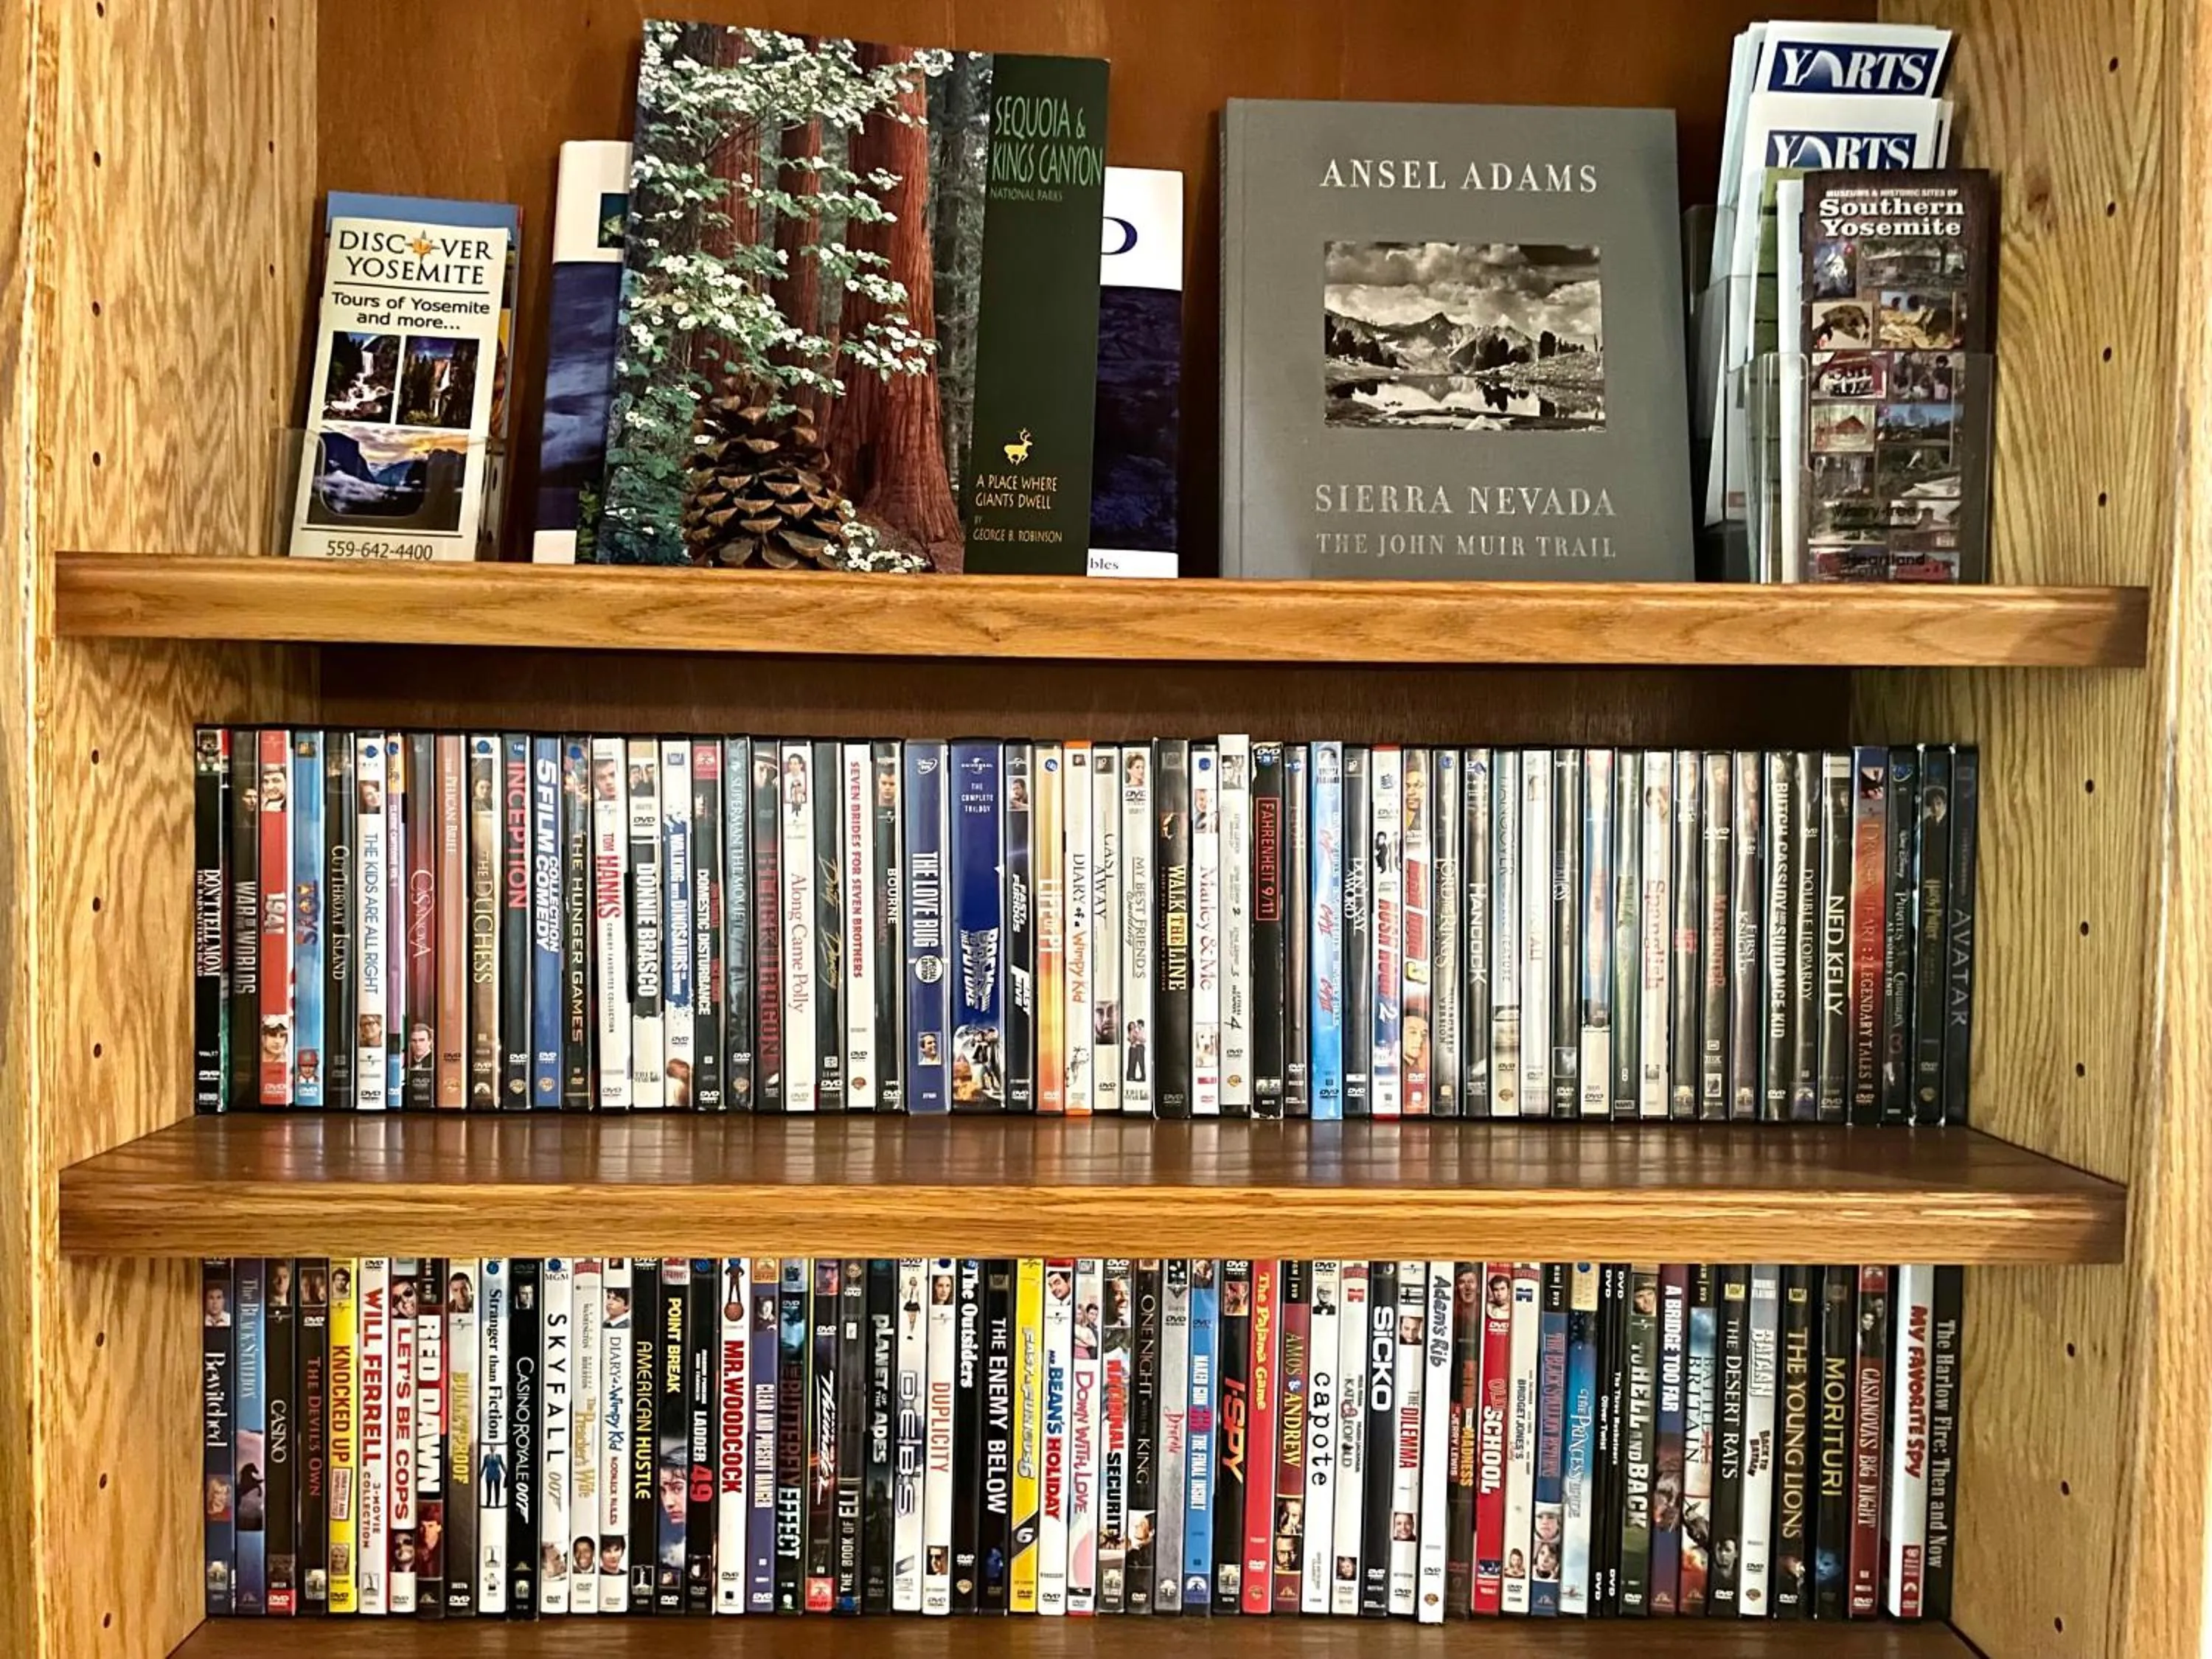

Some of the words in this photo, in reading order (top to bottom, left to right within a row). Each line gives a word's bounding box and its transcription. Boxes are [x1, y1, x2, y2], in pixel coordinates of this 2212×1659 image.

[995, 96, 1070, 139] SEQUOIA
[1075, 108, 1086, 140] &
[992, 142, 1034, 184] KINGS
[1038, 145, 1104, 187] CANYON
[1319, 158, 1447, 189] ANSEL
[1459, 161, 1599, 193] ADAMS
[990, 187, 1034, 201] NATIONAL
[1818, 197, 1965, 218] Southern
[1820, 218, 1962, 238] Yosemite
[345, 255, 484, 285] YOSEMITE
[332, 291, 379, 308] Tours
[387, 295, 406, 310] of
[411, 297, 490, 315] Yosemite
[356, 310, 391, 326] and
[397, 314, 461, 330] more...
[975, 492, 1014, 509] GIANTS
[1018, 493, 1051, 510] DWELL
[976, 474, 986, 489] A
[988, 474, 1019, 491] PLACE
[1021, 476, 1058, 493] WHERE
[1315, 483, 1454, 514] SIERRA
[1468, 485, 1618, 517] NEVADA
[325, 539, 433, 561] 559-642-4400
[973, 528, 1006, 542] GEORGE
[1018, 530, 1063, 544] ROBINSON
[1315, 532, 1368, 555] THE
[1377, 534, 1445, 557] JOHN
[1456, 535, 1526, 557] MUIR
[1536, 537, 1618, 559] TRAIL
[537, 759, 556, 785] 5
[850, 762, 860, 801] SEVEN
[507, 762, 526, 908] INCEPTION
[537, 785, 554, 850] FILM
[851, 803, 861, 847] BRIDES
[364, 832, 378, 858] THE
[477, 850, 490, 877] THE
[571, 832, 583, 870] THE
[602, 832, 614, 851] TOM
[851, 852, 861, 875] FOR
[1260, 803, 1275, 883] FAHRENHEIT
[365, 860, 378, 894] KIDS
[597, 855, 622, 919] HANKS
[912, 852, 937, 878] THE
[1168, 863, 1186, 912] WALK
[234, 881, 256, 915] WAR
[265, 891, 286, 935] 1941
[365, 897, 378, 922] ARE
[536, 855, 549, 950] COMEDY
[549, 856, 559, 953] COLLECTION
[636, 862, 657, 925] DONNIE
[697, 869, 710, 929] DOMESTIC
[787, 873, 805, 920] Along
[852, 878, 862, 915] SEVEN
[887, 868, 897, 924] BOURNE
[912, 880, 939, 915] LOVE
[1260, 886, 1274, 914] 9/11
[365, 925, 378, 950] ALL
[474, 880, 493, 984] DUCHESS
[572, 877, 584, 964] HUNGER
[913, 922, 939, 947] BUG
[1170, 915, 1185, 944] THE
[1468, 882, 1486, 985] HANCOCK
[234, 931, 256, 994] WORLDS
[637, 928, 658, 995] BRASCO
[791, 923, 807, 970] Came
[852, 918, 863, 978] BROTHERS
[1168, 945, 1186, 990] LINE
[1950, 908, 1972, 1026] AVATAR
[364, 953, 378, 994] RIGHT
[698, 933, 711, 1015] DISTURBANCE
[788, 973, 808, 1013] Polly
[572, 970, 584, 1044] GAMES
[1858, 964, 1875, 1035] LEGENDARY
[1858, 1041, 1873, 1079] TALES
[961, 1267, 978, 1300] The
[1257, 1272, 1270, 1303] The
[1430, 1276, 1450, 1335] Adam's
[1666, 1285, 1680, 1296] A
[364, 1287, 383, 1347] WILL
[485, 1289, 502, 1351] Stranger
[668, 1298, 681, 1340] POINT
[990, 1318, 1006, 1350] THE
[1139, 1294, 1155, 1339] ONE
[1256, 1305, 1270, 1364] Pajama
[1663, 1298, 1680, 1352] BRIDGE
[1726, 1319, 1739, 1349] THE
[1935, 1320, 1955, 1349] The
[396, 1327, 411, 1399] LET'S
[418, 1315, 441, 1380] RED
[489, 1354, 499, 1382] than
[959, 1304, 978, 1388] Outsiders
[1138, 1339, 1154, 1398] NIGHT
[1429, 1338, 1449, 1368] Rib
[1662, 1354, 1678, 1383] TOO
[1786, 1328, 1806, 1374] THE
[332, 1346, 351, 1432] KNOCKED
[636, 1341, 653, 1431] AMERICAN
[667, 1345, 681, 1393] BREAK
[1256, 1367, 1269, 1411] Game
[1723, 1355, 1741, 1427] DESERT
[1935, 1354, 1954, 1410] Harlow
[205, 1351, 226, 1447] Bewitched
[362, 1354, 383, 1467] FERRELL
[488, 1385, 502, 1439] Fiction
[756, 1384, 775, 1411] CLEAR
[989, 1356, 1007, 1430] ENEMY
[1661, 1385, 1677, 1412] FAR
[271, 1400, 286, 1464] CASINO
[396, 1406, 410, 1439] BE
[417, 1388, 439, 1492] DAWN
[452, 1372, 470, 1484] BULLETPROOF
[693, 1411, 707, 1461] LADDER
[756, 1413, 773, 1431] AND
[930, 1382, 950, 1472] DUPLICITY
[1308, 1372, 1332, 1486] capote
[1784, 1381, 1806, 1466] YOUNG
[1820, 1357, 1846, 1497] MORITURI
[1933, 1416, 1952, 1453] Fire:
[332, 1439, 350, 1462] UP
[635, 1437, 651, 1499] HUSTLE
[755, 1433, 773, 1471] PRESENT
[1135, 1439, 1152, 1485] KING
[1460, 1427, 1474, 1486] MADNESS
[1722, 1433, 1739, 1479] RATS
[395, 1450, 410, 1520] COPS
[689, 1465, 714, 1502] 49
[754, 1474, 773, 1508] DANGER
[987, 1440, 1007, 1514] BELOW
[1931, 1458, 1950, 1497] Then
[362, 1472, 370, 1548] COLLECTION
[1781, 1472, 1804, 1539] LIONS
[1929, 1501, 1946, 1530] and
[1927, 1535, 1947, 1568] Now
